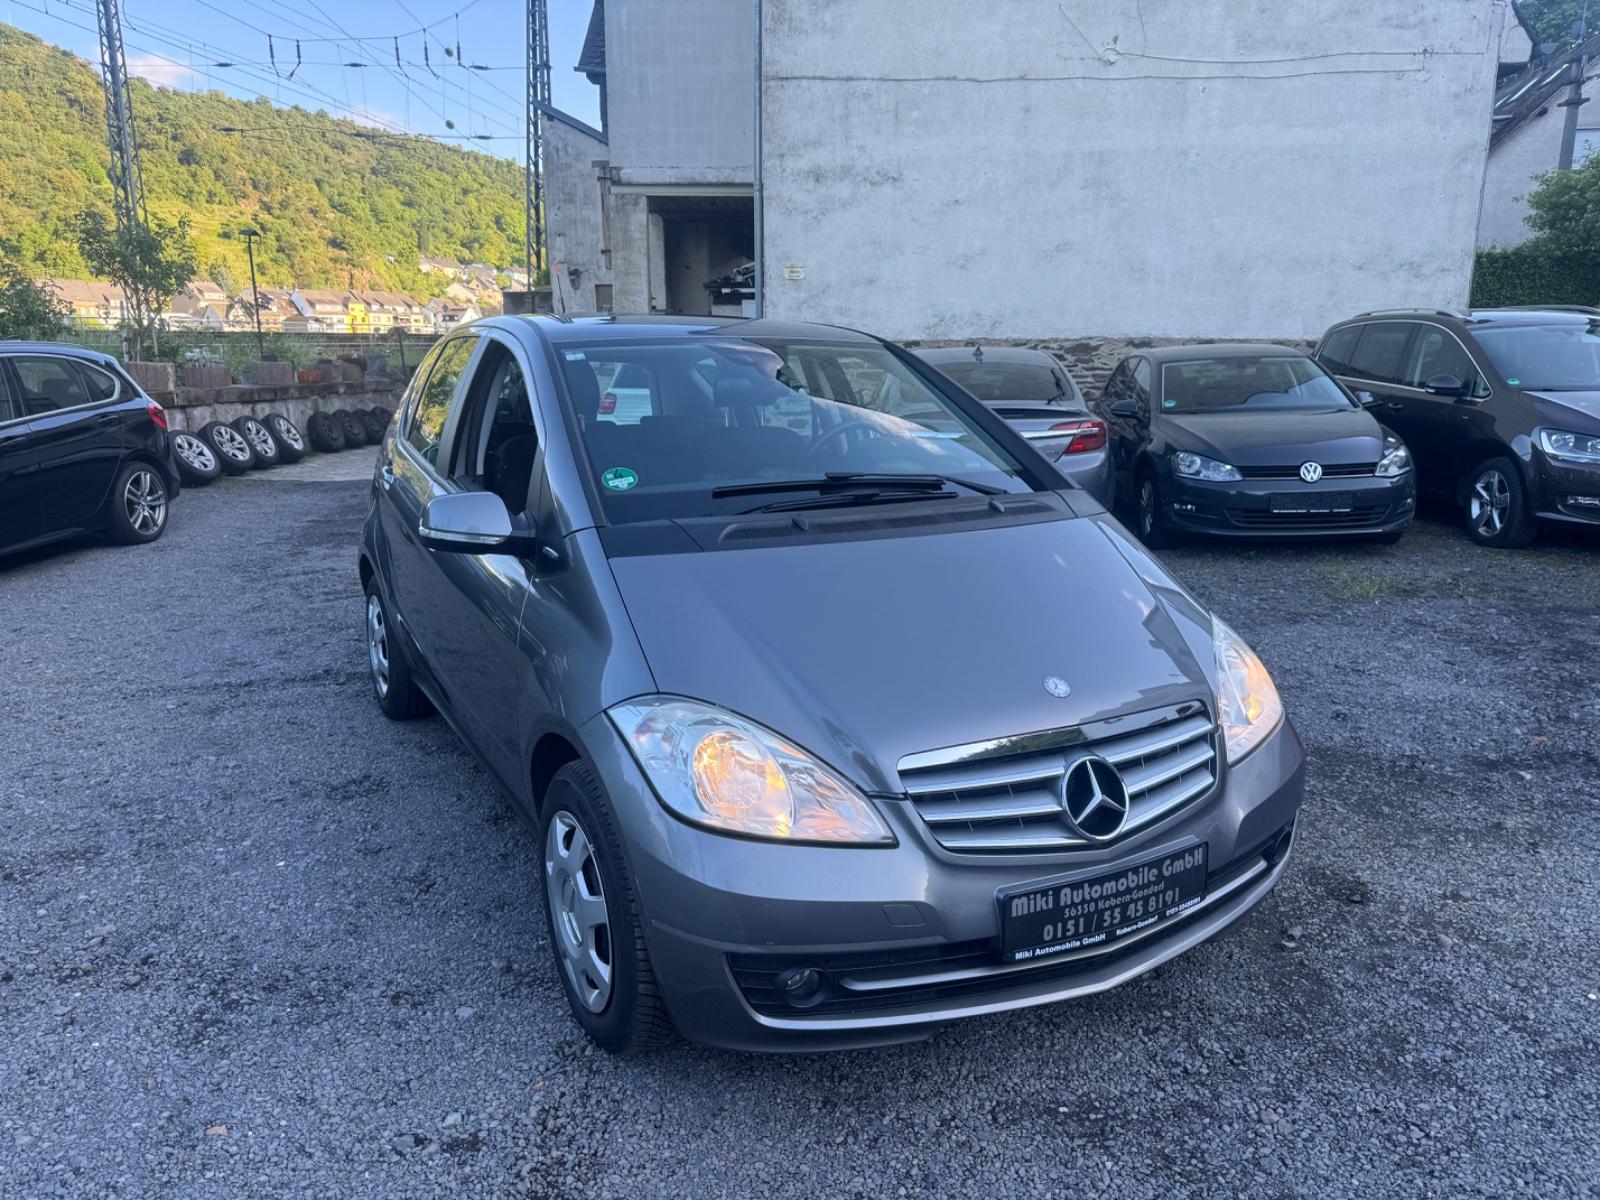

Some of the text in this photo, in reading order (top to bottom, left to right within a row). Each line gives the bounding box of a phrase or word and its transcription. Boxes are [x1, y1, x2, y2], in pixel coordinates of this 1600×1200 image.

[1011, 847, 1203, 917] Miki Automobile GmbH
[1064, 902, 1095, 918] 56330
[1098, 880, 1165, 910] Kobern-Gondorf
[1043, 917, 1084, 941] 0151
[1103, 907, 1121, 927] 55
[1126, 900, 1144, 919] 45
[1148, 887, 1180, 912] 8191
[1015, 949, 1033, 960] Miki
[1034, 940, 1081, 956] Automobile
[1082, 933, 1106, 945] GmbH
